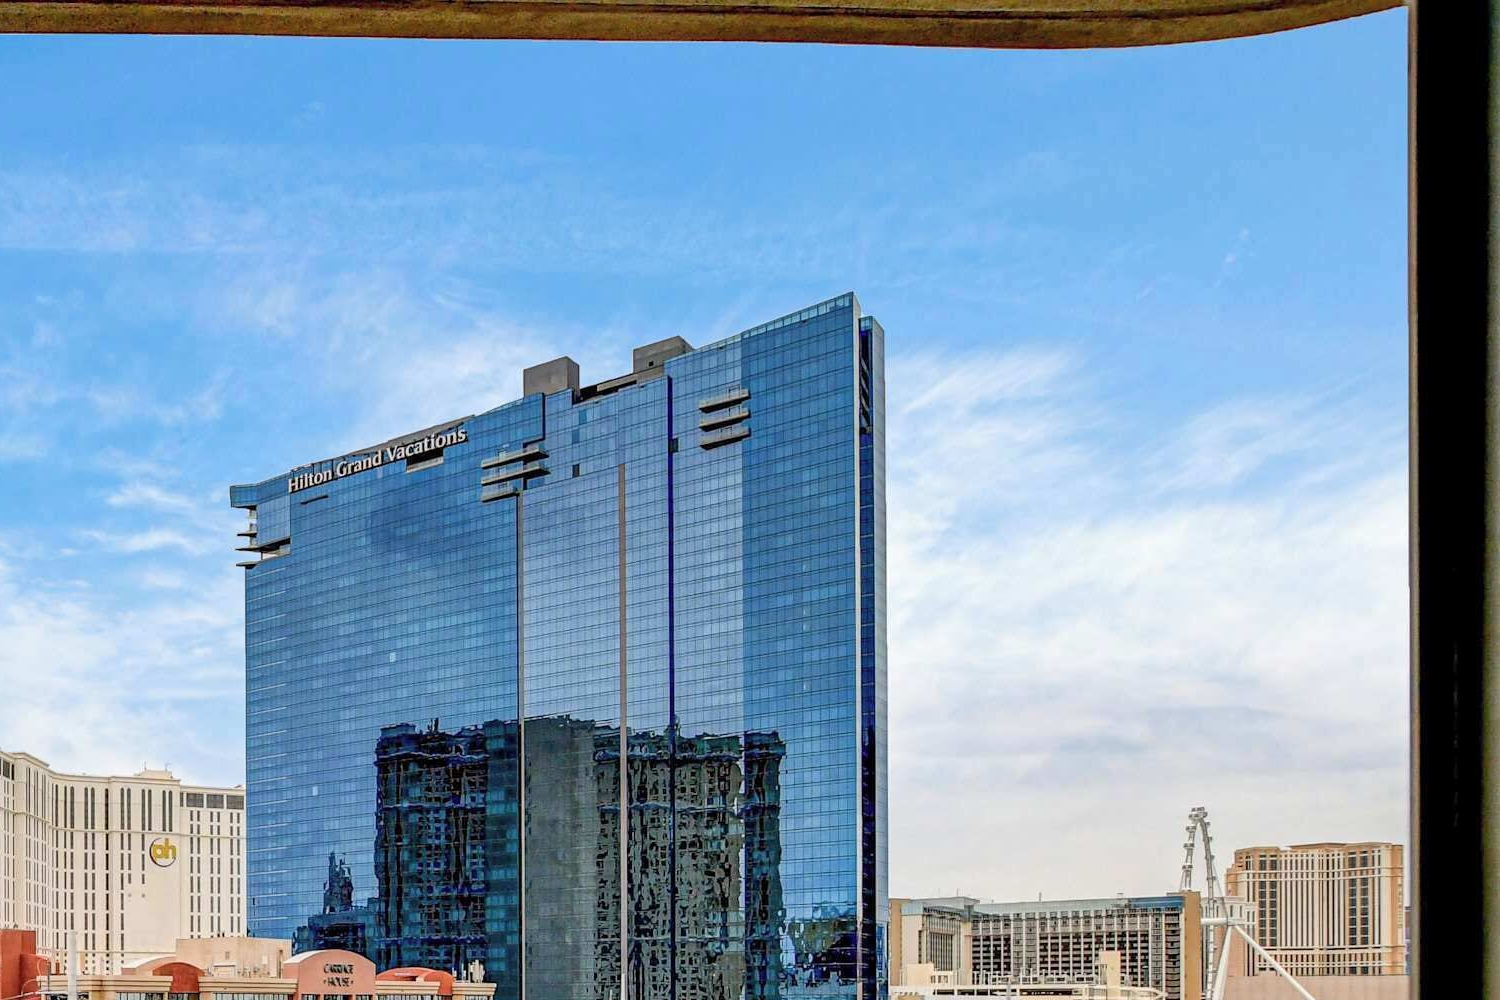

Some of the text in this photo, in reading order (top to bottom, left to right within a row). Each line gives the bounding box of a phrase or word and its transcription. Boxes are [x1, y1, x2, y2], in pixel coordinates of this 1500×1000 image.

[288, 429, 468, 493] Hilton Grand Vacations
[153, 837, 177, 860] ph
